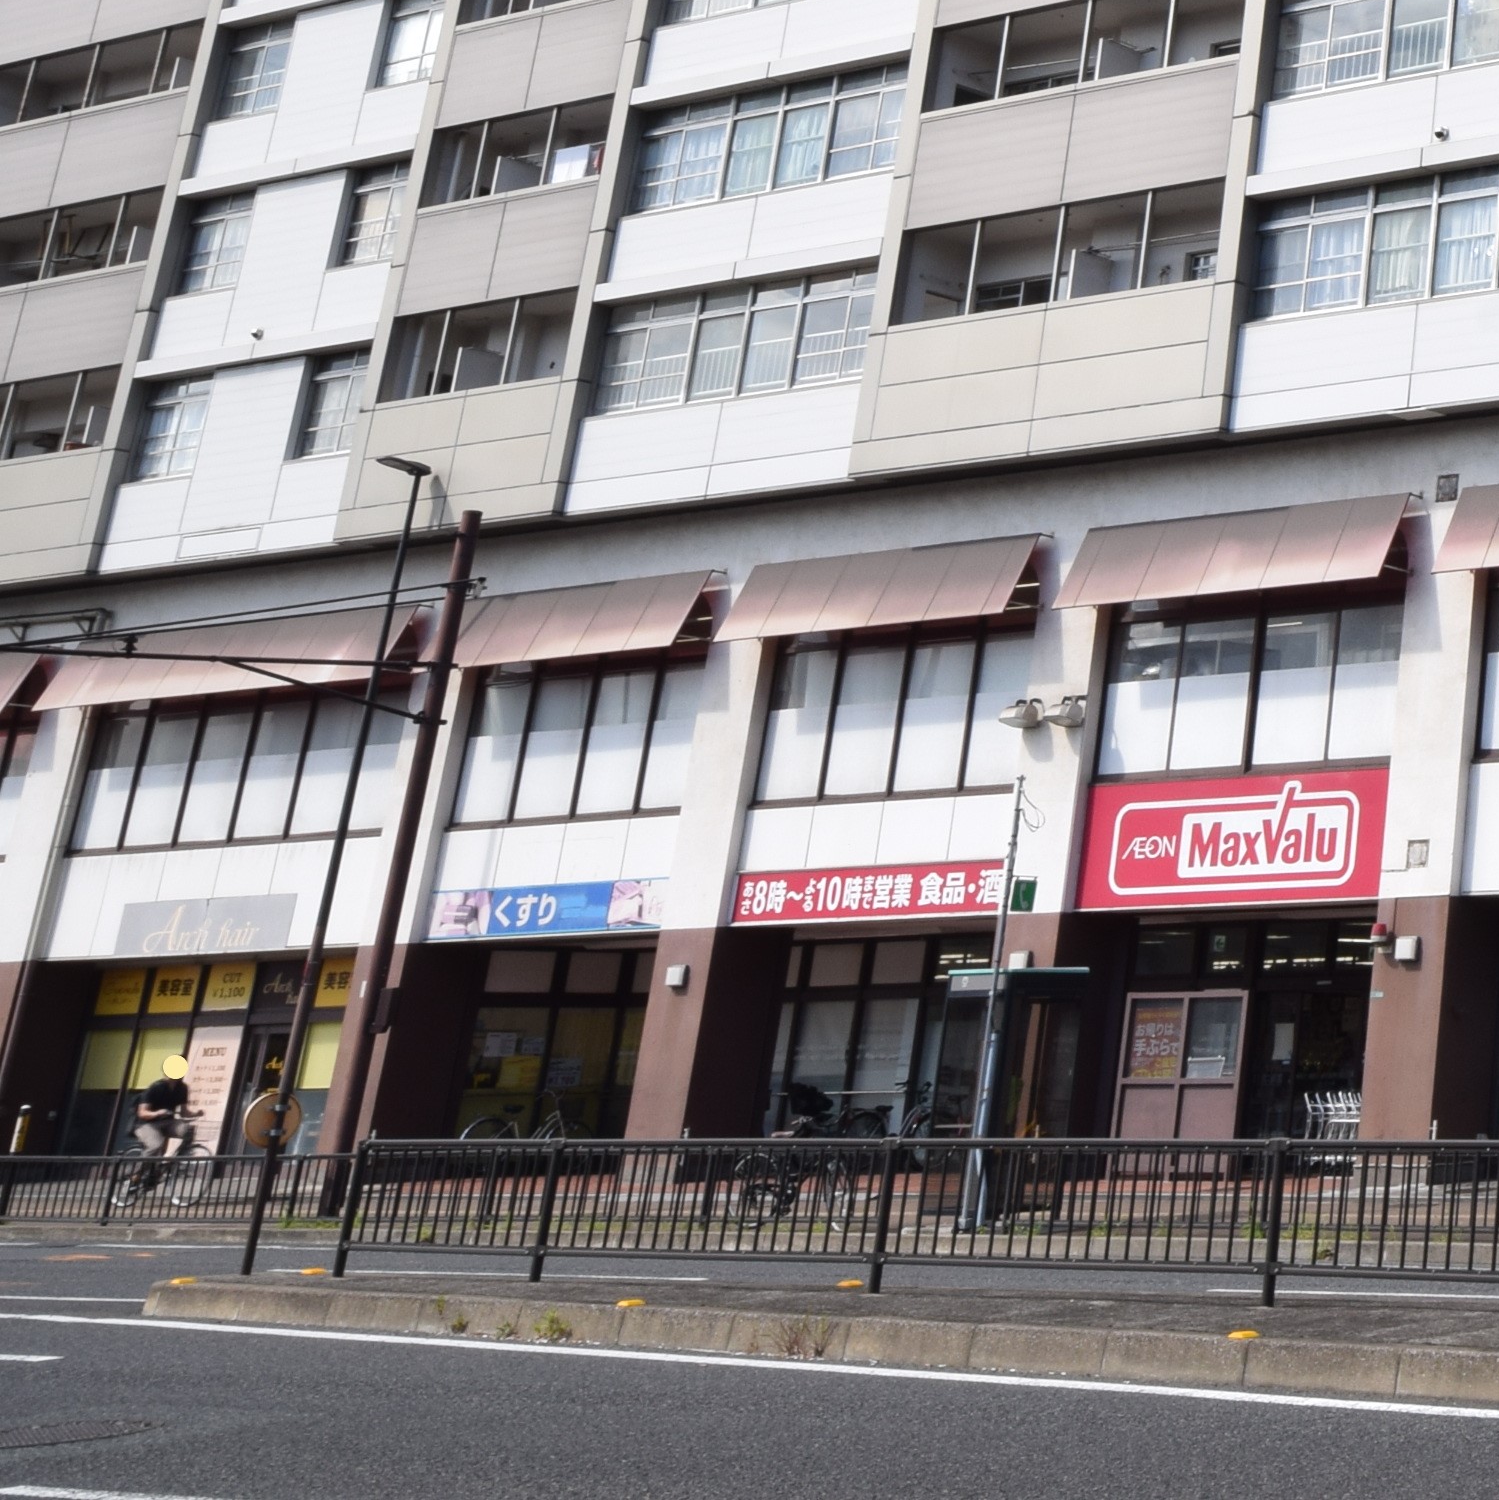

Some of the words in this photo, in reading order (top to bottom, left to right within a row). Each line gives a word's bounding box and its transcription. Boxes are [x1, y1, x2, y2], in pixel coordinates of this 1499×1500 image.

[1188, 786, 1338, 868] MaxValu
[495, 893, 556, 928] くすり
[143, 904, 208, 952] Arch
[215, 919, 260, 948] hair
[157, 978, 195, 997] 美容室
[222, 972, 242, 984] CUT
[202, 1046, 227, 1057] MENU
